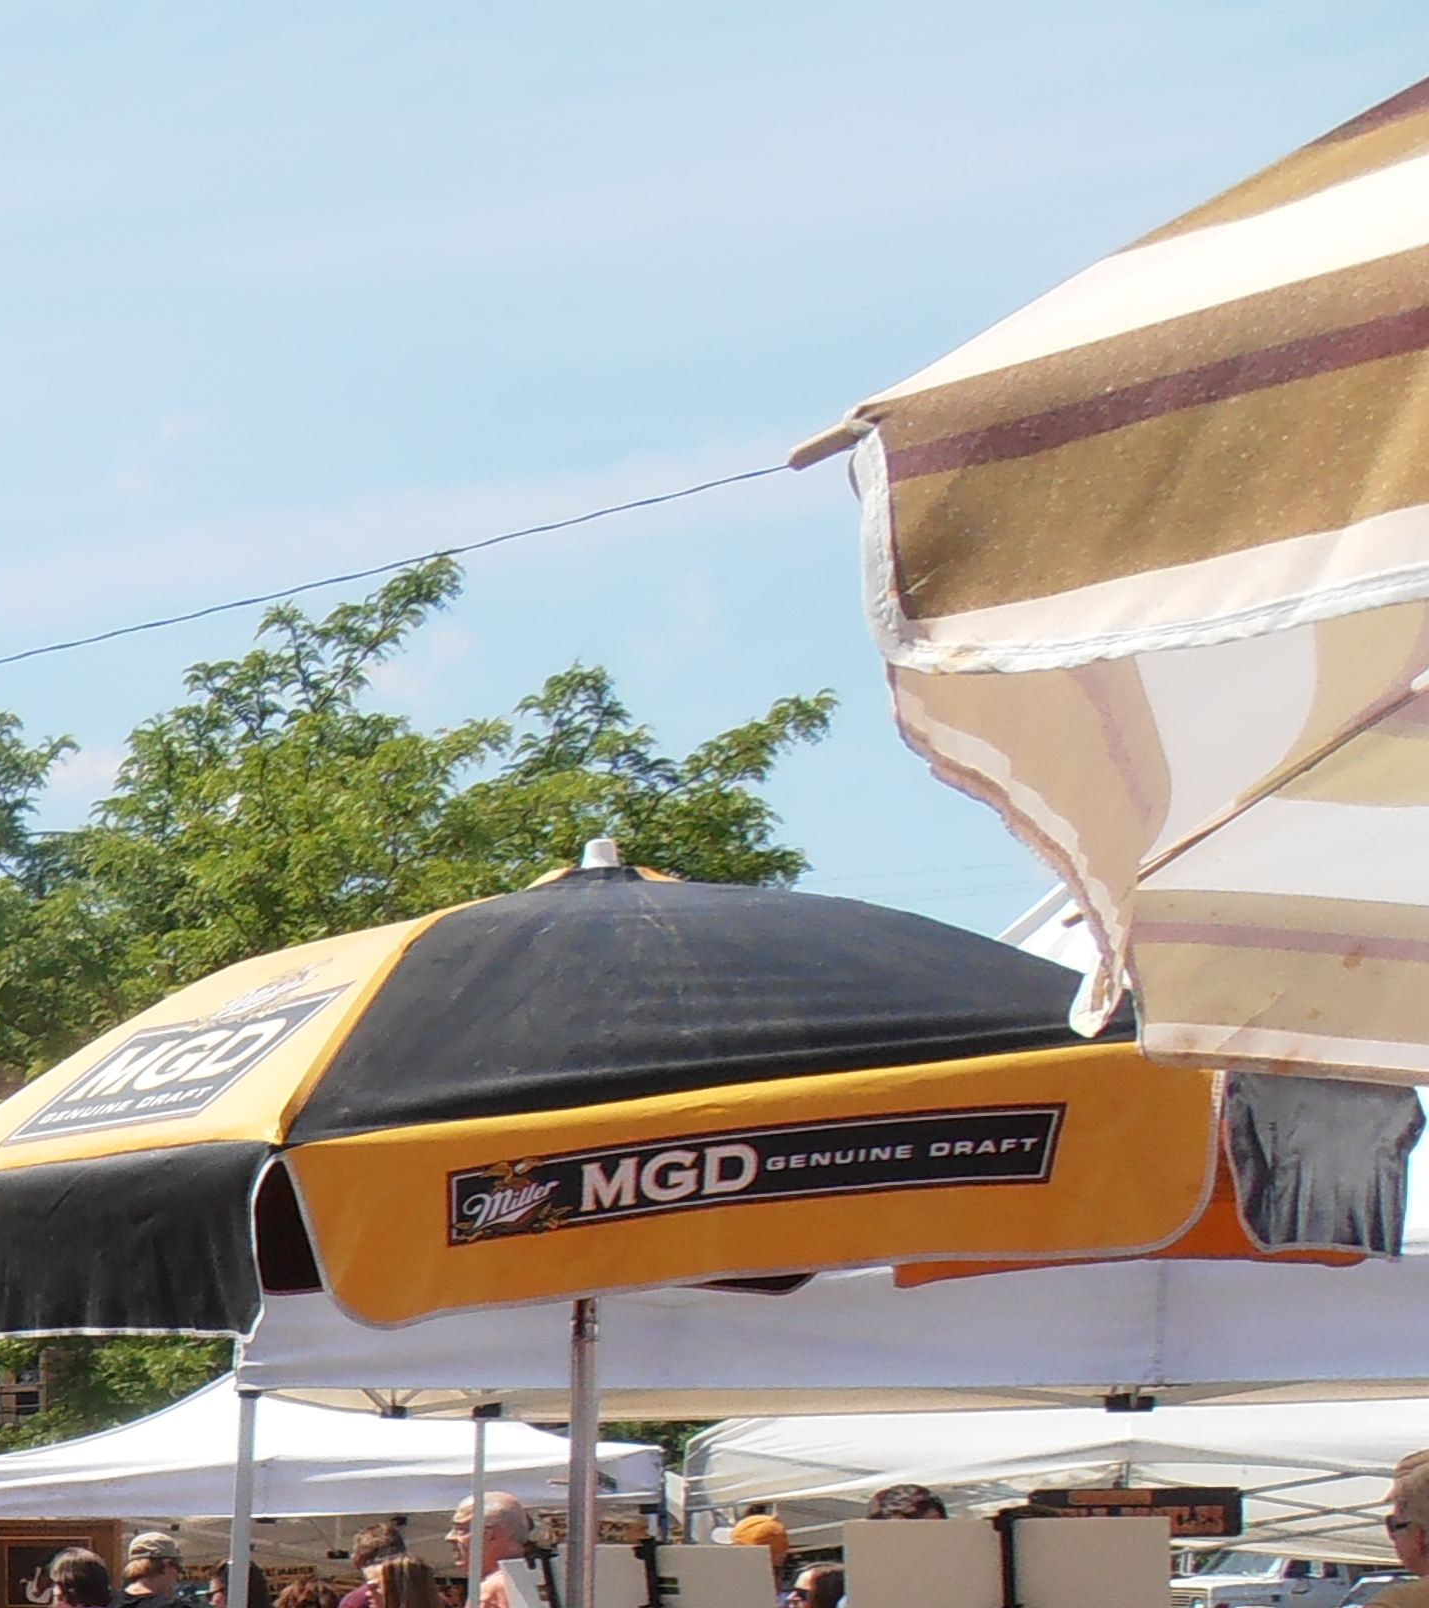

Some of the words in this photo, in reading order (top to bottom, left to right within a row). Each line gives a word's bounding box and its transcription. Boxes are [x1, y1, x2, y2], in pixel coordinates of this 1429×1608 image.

[63, 1017, 288, 1103] MGD
[37, 1099, 136, 1125] GENUINE
[139, 1085, 215, 1109] DRAFT
[462, 1180, 561, 1229] Miller
[579, 1142, 760, 1214] MGD
[764, 1144, 914, 1173] GENUINE
[928, 1136, 1041, 1159] DRAFT
